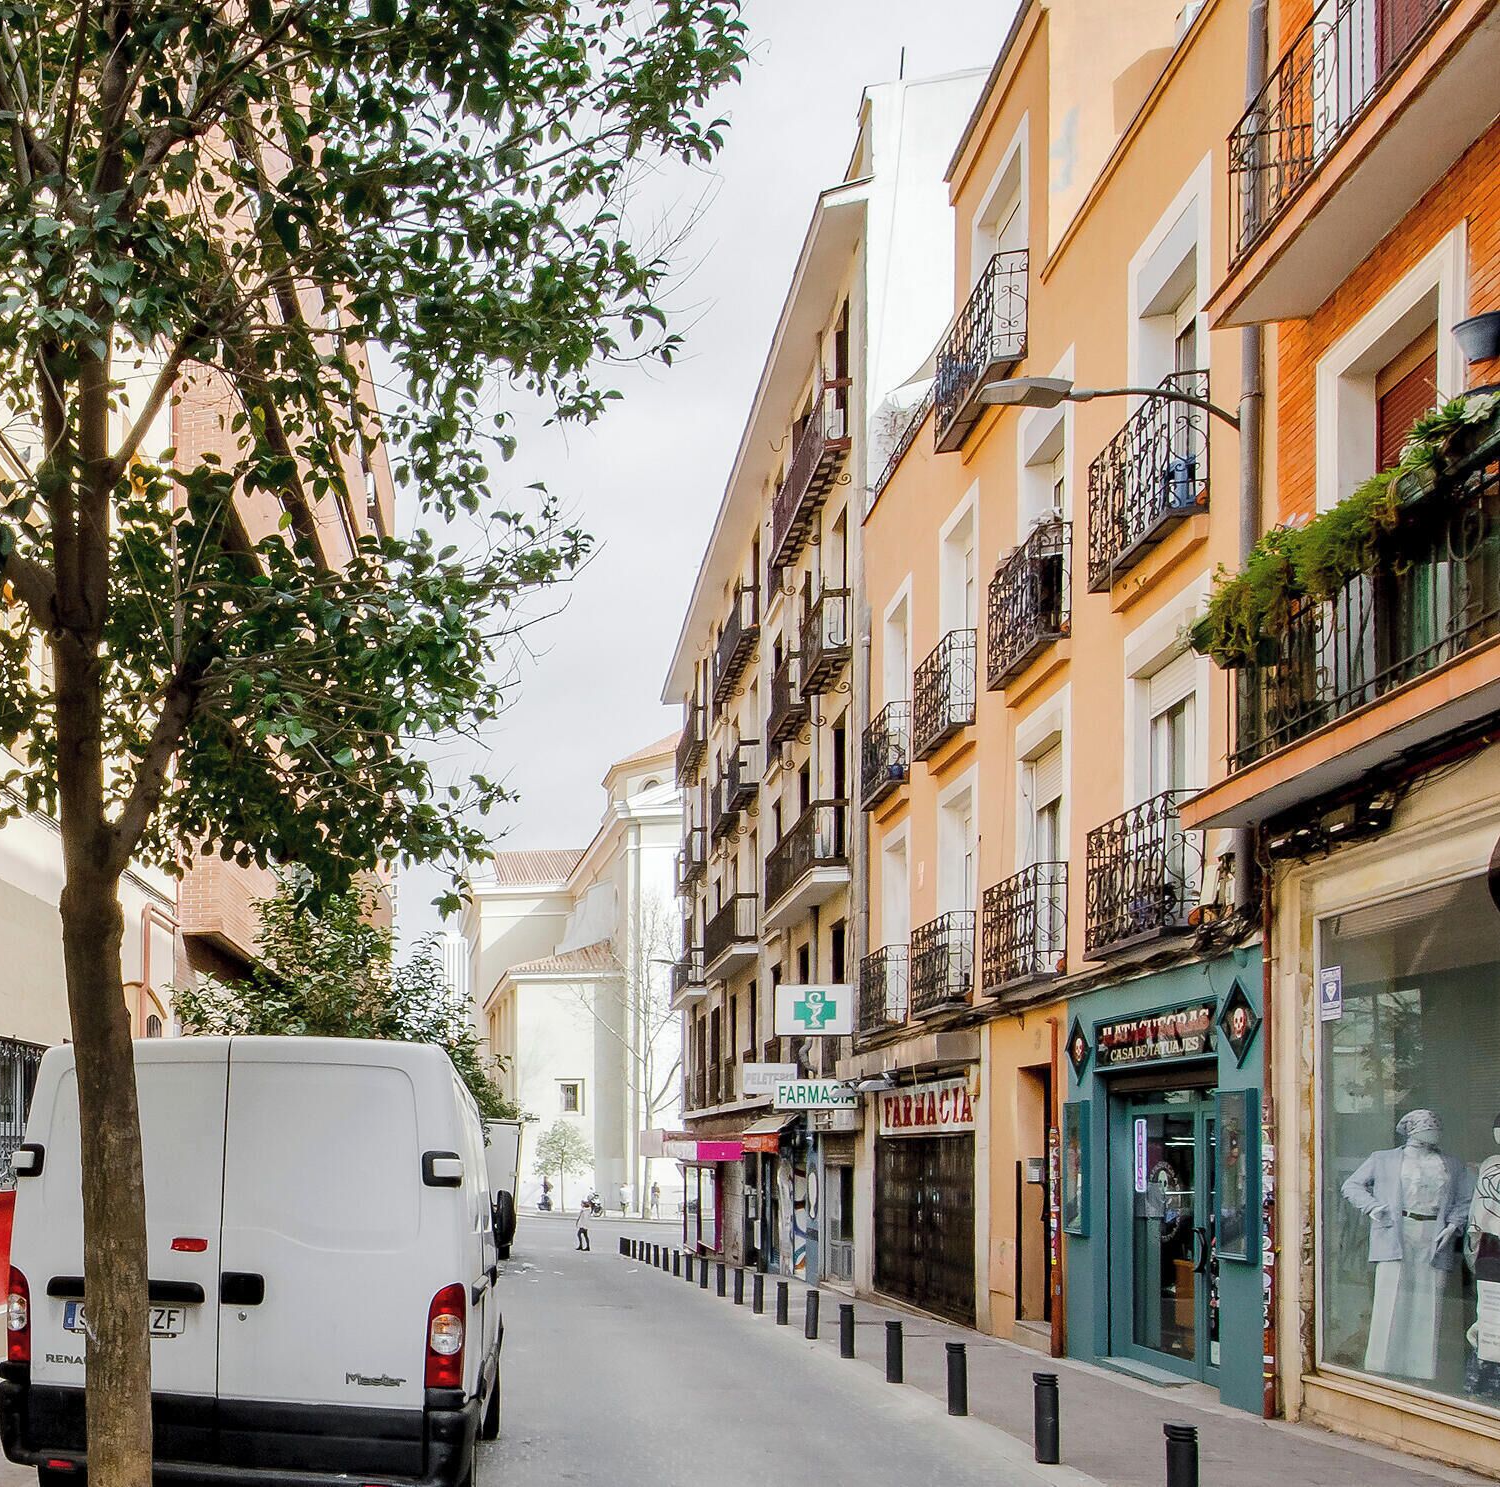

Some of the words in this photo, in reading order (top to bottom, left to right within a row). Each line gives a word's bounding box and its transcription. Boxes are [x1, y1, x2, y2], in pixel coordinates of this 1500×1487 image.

[1110, 1047, 1134, 1062] CASA
[1135, 1044, 1148, 1057] DE
[1149, 1036, 1199, 1056] TATUAJES
[884, 1086, 973, 1127] FARMACIA
[150, 1309, 180, 1330] ZF
[45, 1353, 87, 1365] RENA
[346, 1372, 407, 1387] Master
